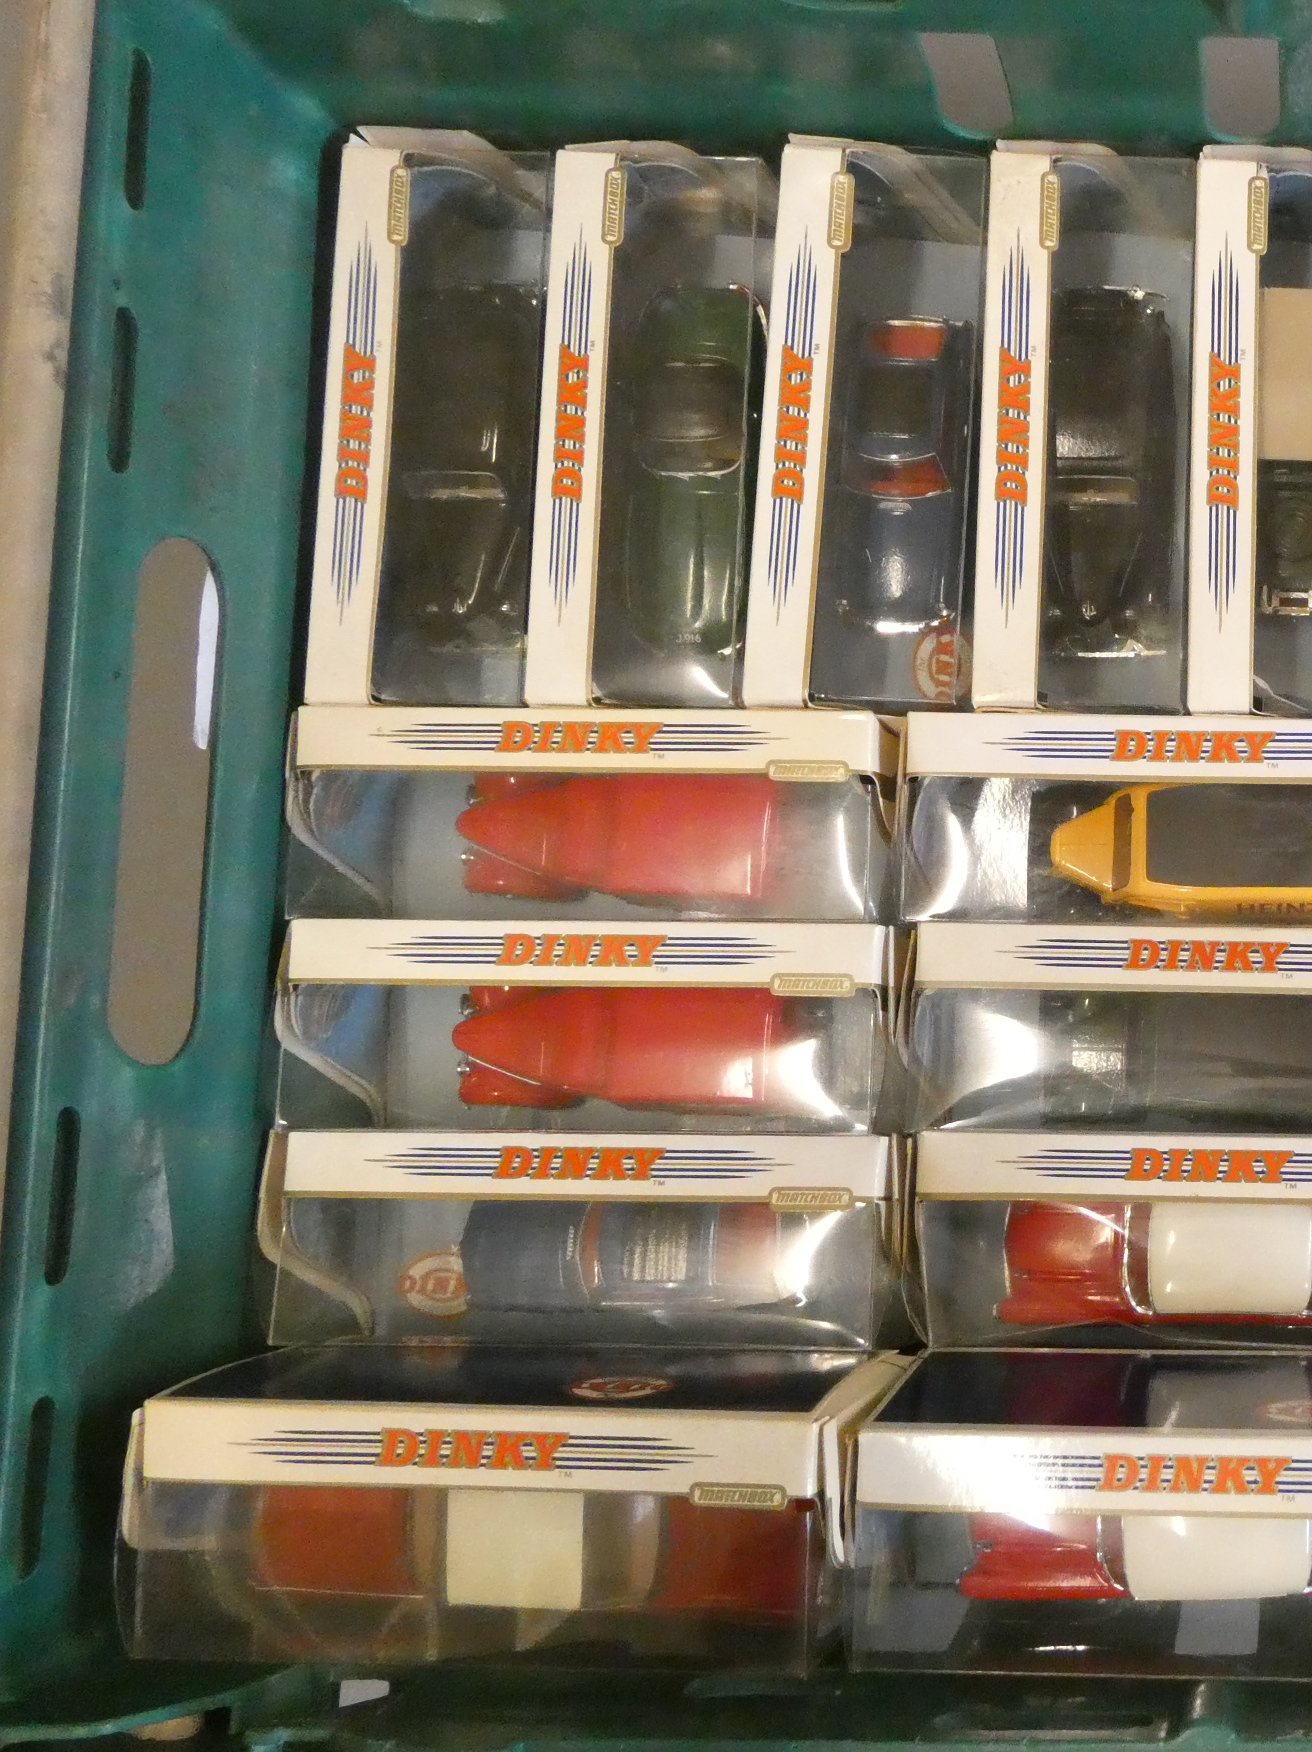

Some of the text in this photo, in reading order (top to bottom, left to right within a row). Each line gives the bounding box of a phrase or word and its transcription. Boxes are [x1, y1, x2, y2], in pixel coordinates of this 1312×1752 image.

[335, 343, 377, 503] DINKY
[550, 344, 590, 502] DINKY
[771, 346, 814, 503] DINKY
[995, 347, 1032, 506] DINKY
[1206, 353, 1242, 509] DINKY
[495, 721, 663, 754] DINKY
[1111, 729, 1276, 763] DINKY
[497, 933, 666, 967] DINKY
[1123, 938, 1290, 973] DINKY
[493, 1146, 666, 1182] DINKY
[1127, 1148, 1294, 1185] DINKY
[378, 1428, 569, 1472] DINKY
[1098, 1453, 1291, 1495] DINKY
